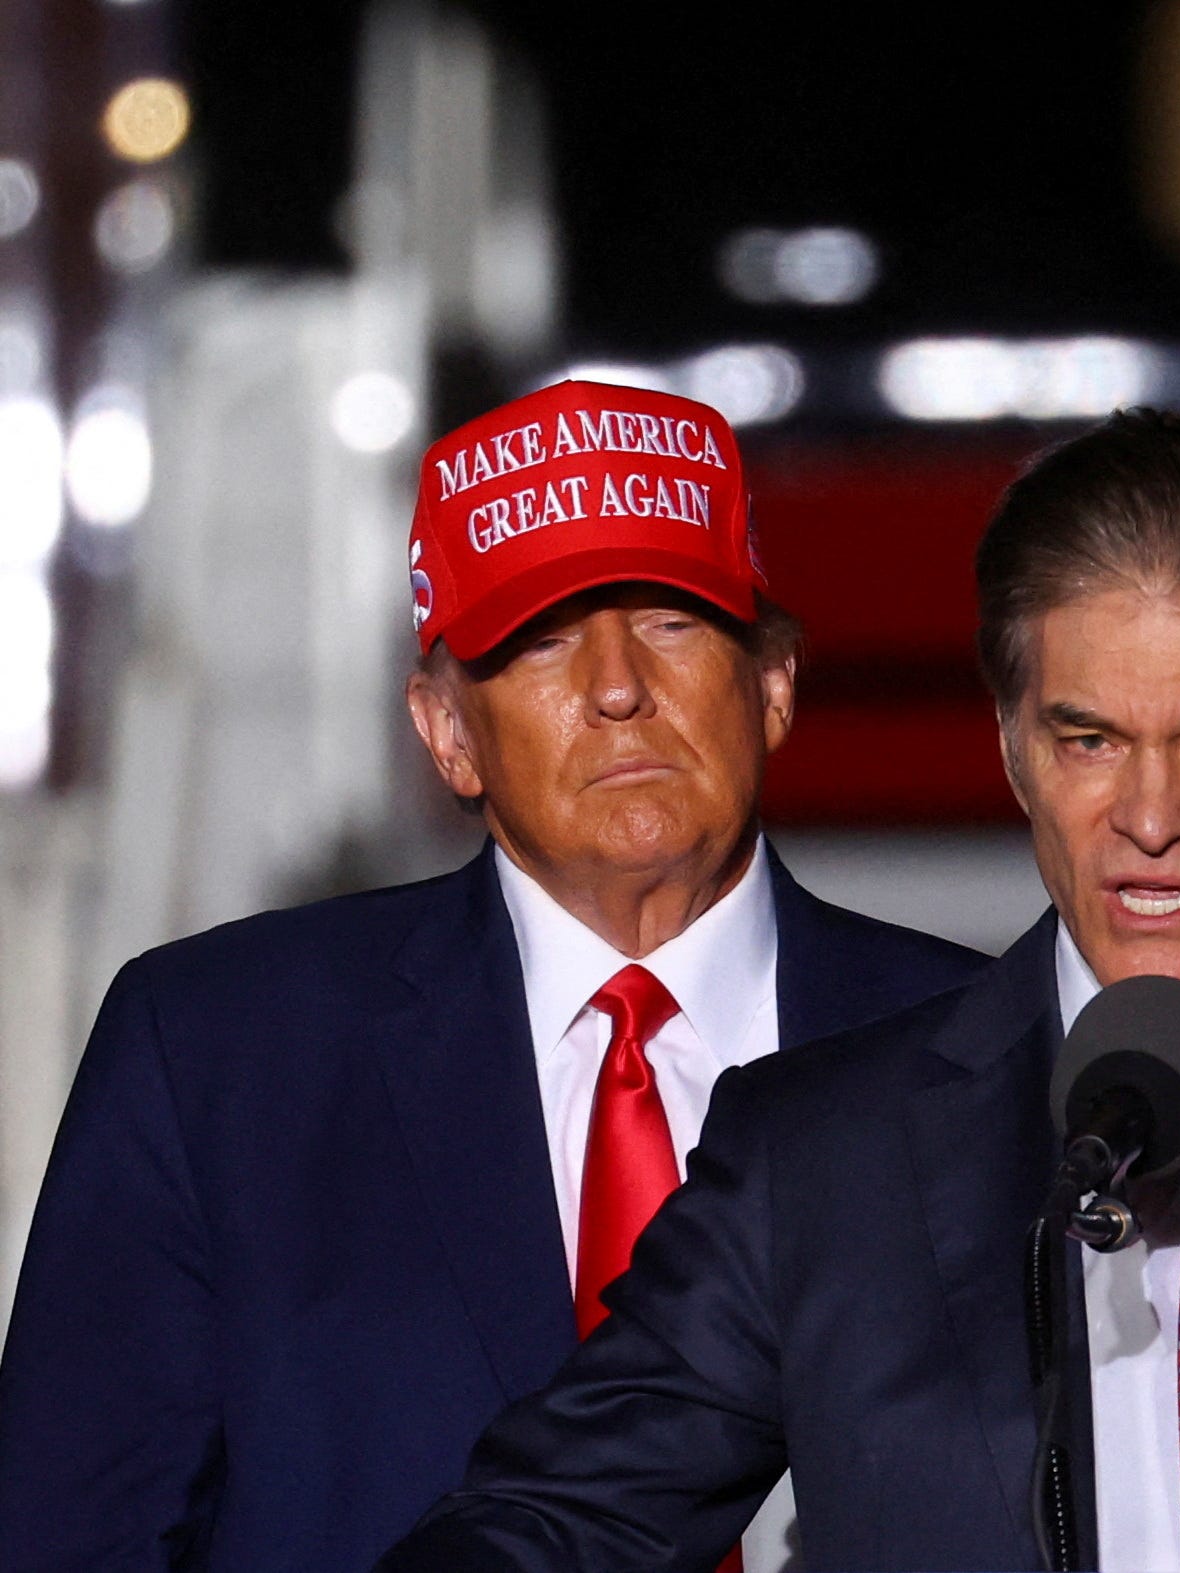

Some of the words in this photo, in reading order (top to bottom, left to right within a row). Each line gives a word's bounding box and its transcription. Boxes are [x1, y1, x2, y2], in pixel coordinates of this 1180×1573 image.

[435, 421, 547, 501] MAKE
[552, 409, 727, 470] AMERICA
[467, 476, 589, 554] GREAT
[600, 472, 711, 530] AGAIN
